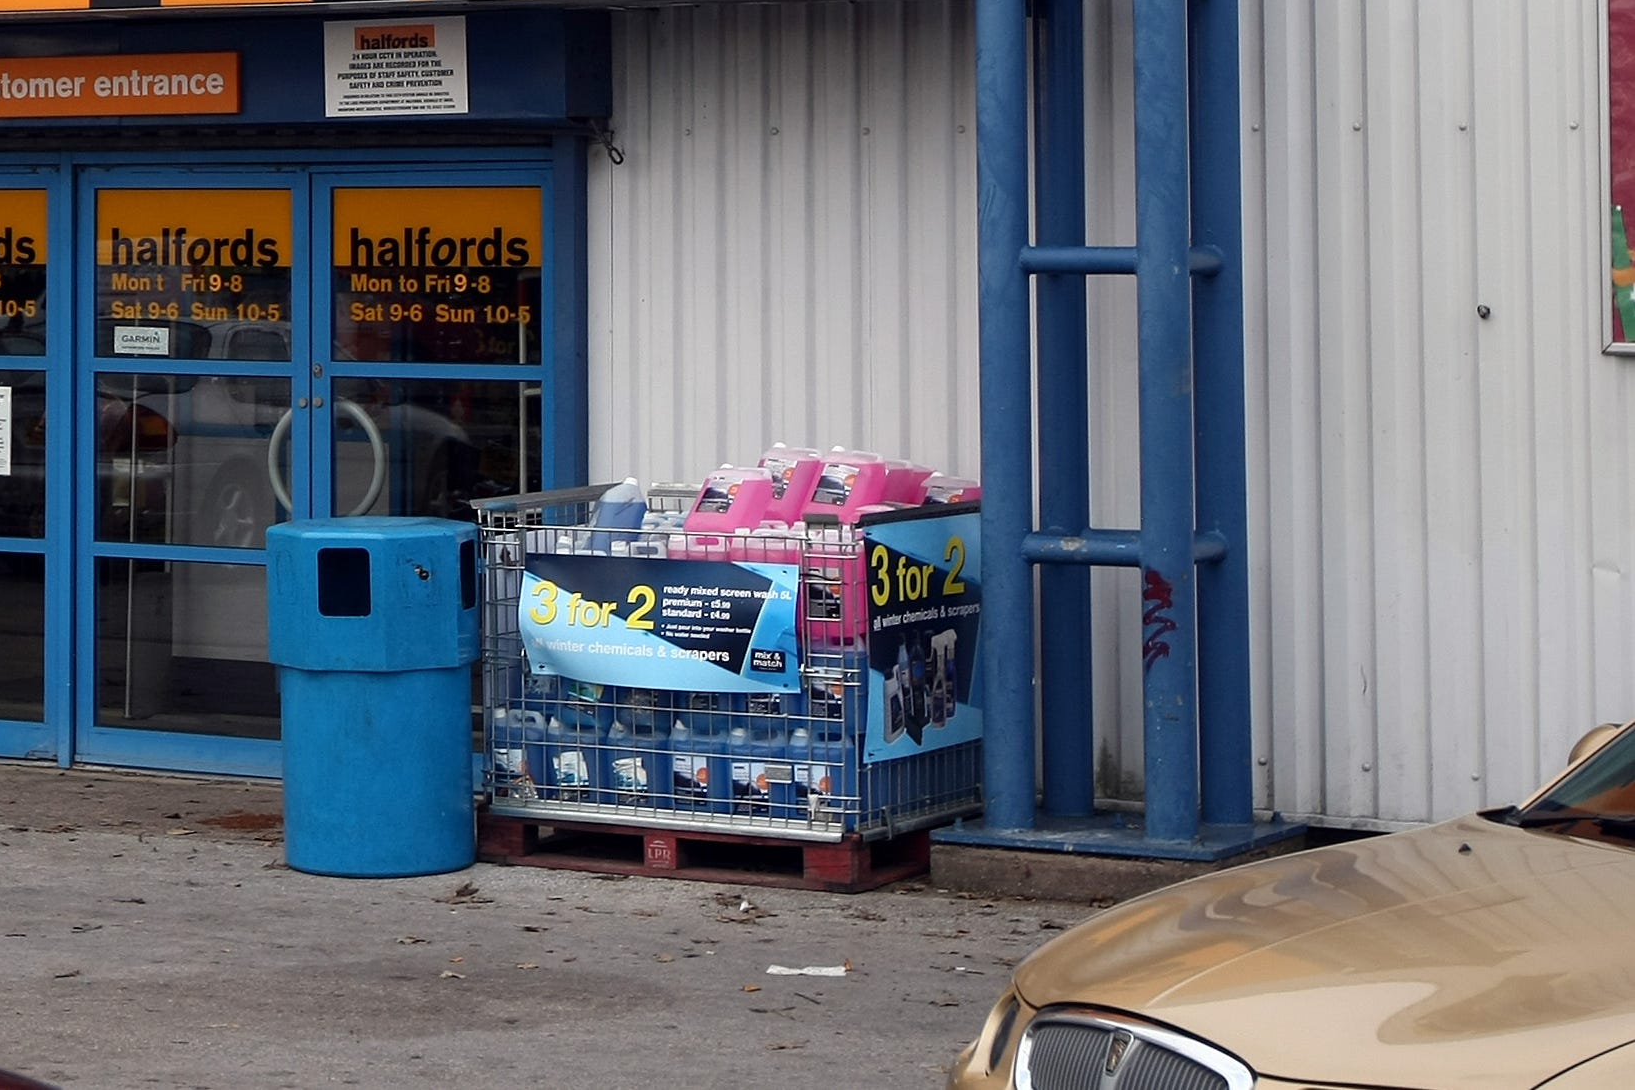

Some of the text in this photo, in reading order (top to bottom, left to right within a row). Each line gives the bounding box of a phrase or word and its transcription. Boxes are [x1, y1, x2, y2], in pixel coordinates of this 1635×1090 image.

[360, 33, 429, 50] halfords
[352, 53, 360, 61] 24
[93, 68, 225, 97] entrance
[112, 227, 279, 267] halfords
[350, 227, 530, 267] halfords
[112, 273, 150, 291] Mon
[181, 274, 205, 292] Fri
[350, 274, 392, 293] Mon
[399, 274, 418, 293] to
[425, 274, 451, 293] Fri
[111, 301, 280, 322] Sat 9-6 Sun 10-5
[350, 303, 531, 325] Sat 9-6 Sun 10-5
[121, 334, 160, 344] GARMIN
[871, 536, 965, 606] 3 for 2
[663, 585, 689, 596] ready
[691, 586, 718, 596] mixed
[720, 589, 751, 598] screen
[754, 590, 778, 600] wash
[530, 580, 657, 630] 3 for 2
[662, 597, 702, 608] premium
[662, 608, 702, 619] standard
[873, 603, 980, 631] all winter chemicals & scrapers
[546, 640, 584, 654] winter
[588, 642, 653, 657] chemicals
[657, 646, 667, 657] &
[670, 648, 730, 662] scrapers
[754, 651, 781, 660] mix &
[753, 659, 783, 668] match
[648, 848, 671, 860] LPR
